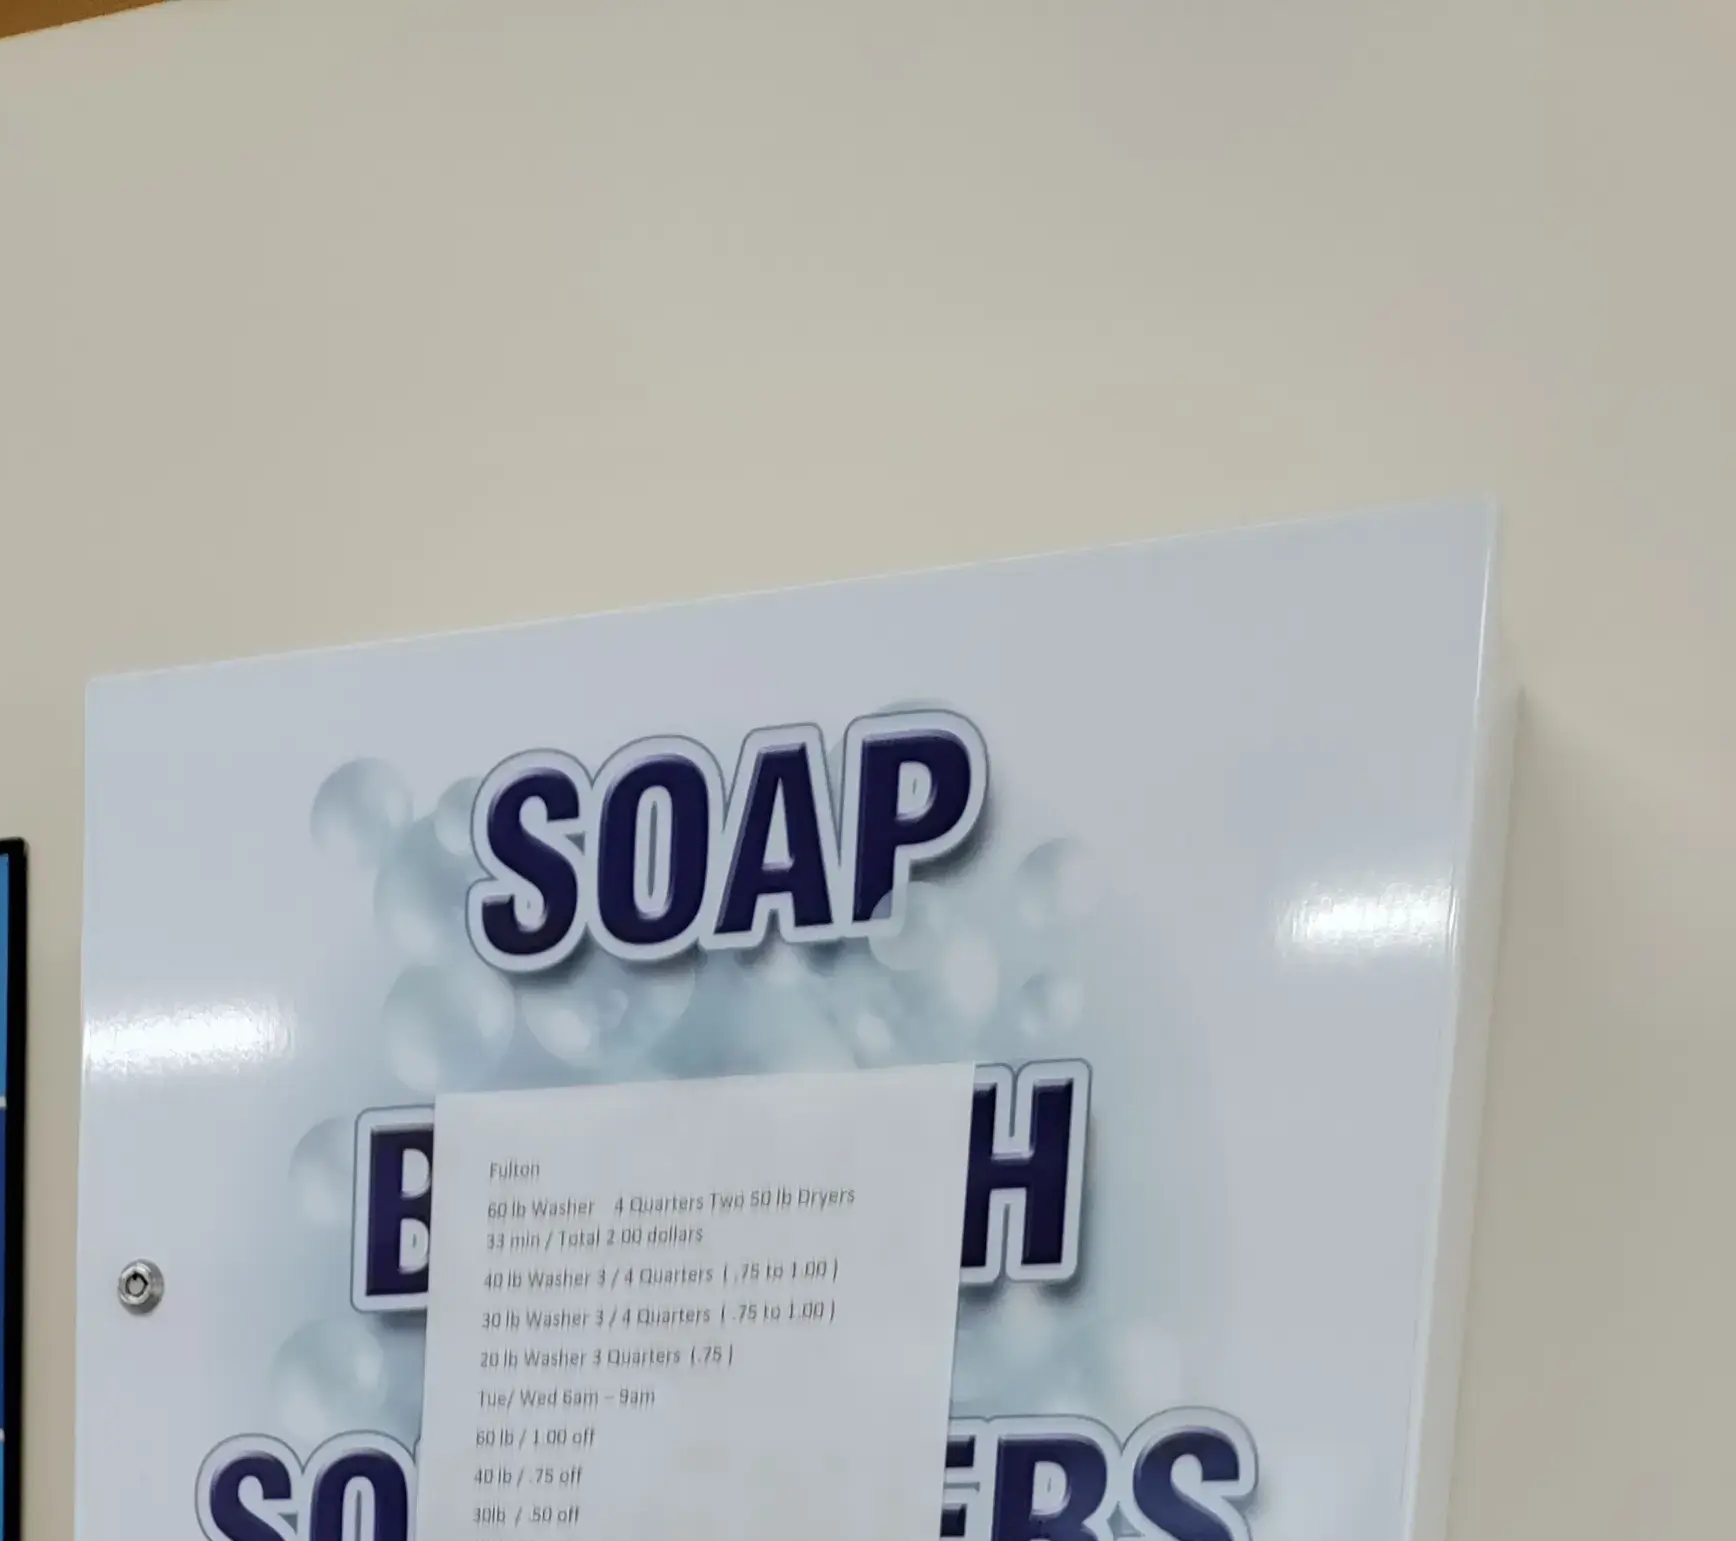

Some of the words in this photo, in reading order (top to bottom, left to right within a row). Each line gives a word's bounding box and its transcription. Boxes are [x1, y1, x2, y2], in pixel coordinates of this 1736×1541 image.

[481, 728, 973, 956] SOAP
[489, 1160, 540, 1180] Fulton
[488, 1202, 507, 1219] 60
[513, 1200, 526, 1218] lb
[532, 1198, 594, 1217] Washer
[615, 1196, 623, 1214] 4
[630, 1194, 704, 1214] Quarters
[710, 1191, 744, 1212] Two
[776, 1186, 791, 1206] lb
[798, 1187, 855, 1209] Dryers
[487, 1232, 504, 1249] 33
[510, 1230, 540, 1249] min
[558, 1226, 600, 1247] Total
[647, 1225, 703, 1246] dollars
[485, 1270, 503, 1289] 40
[508, 1268, 522, 1288] lb
[528, 1266, 591, 1287] Washer
[597, 1268, 605, 1285] 3
[625, 1267, 633, 1284] 4
[640, 1265, 713, 1286] Quarters
[767, 1260, 783, 1280] to
[482, 1312, 501, 1329] 30
[506, 1310, 520, 1329] lb
[526, 1308, 589, 1329] Washer
[595, 1308, 604, 1327] 3
[622, 1307, 631, 1325] 4
[637, 1305, 710, 1326] Quarters
[764, 1302, 780, 1320] to
[480, 1351, 499, 1368] 20
[504, 1350, 517, 1368] lb
[524, 1347, 587, 1367] Washer
[593, 1348, 602, 1366] 3
[608, 1348, 680, 1367] Quarters
[520, 1389, 557, 1408] Wed
[619, 1388, 655, 1407] 9am
[476, 1430, 495, 1446] 60
[500, 1428, 513, 1446] lb
[572, 1427, 595, 1446] off
[474, 1468, 493, 1485] 40
[498, 1466, 512, 1485] lb
[559, 1466, 582, 1485] off
[557, 1506, 579, 1523] off
